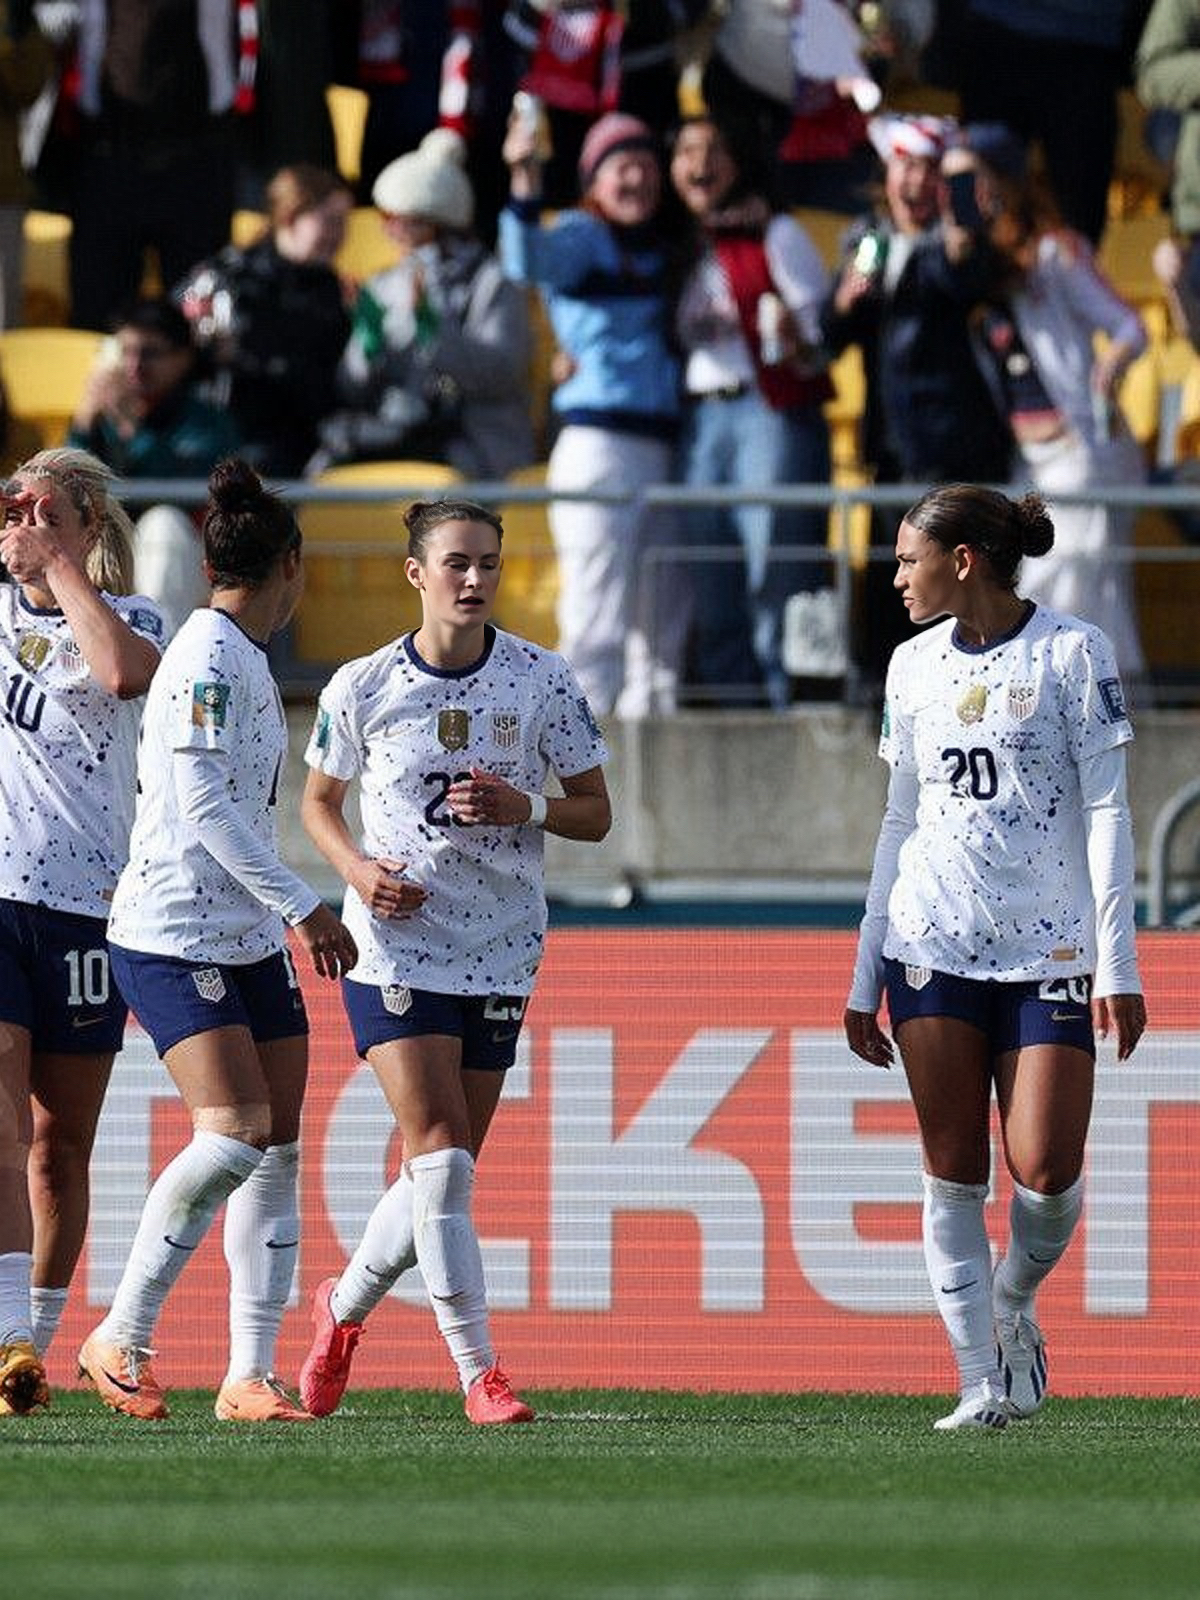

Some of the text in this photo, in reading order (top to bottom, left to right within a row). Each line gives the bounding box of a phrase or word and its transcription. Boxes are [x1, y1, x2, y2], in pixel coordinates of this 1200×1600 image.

[6, 673, 47, 733] 10
[492, 715, 518, 731] USA
[941, 747, 998, 801] 20
[64, 949, 110, 1006] 10
